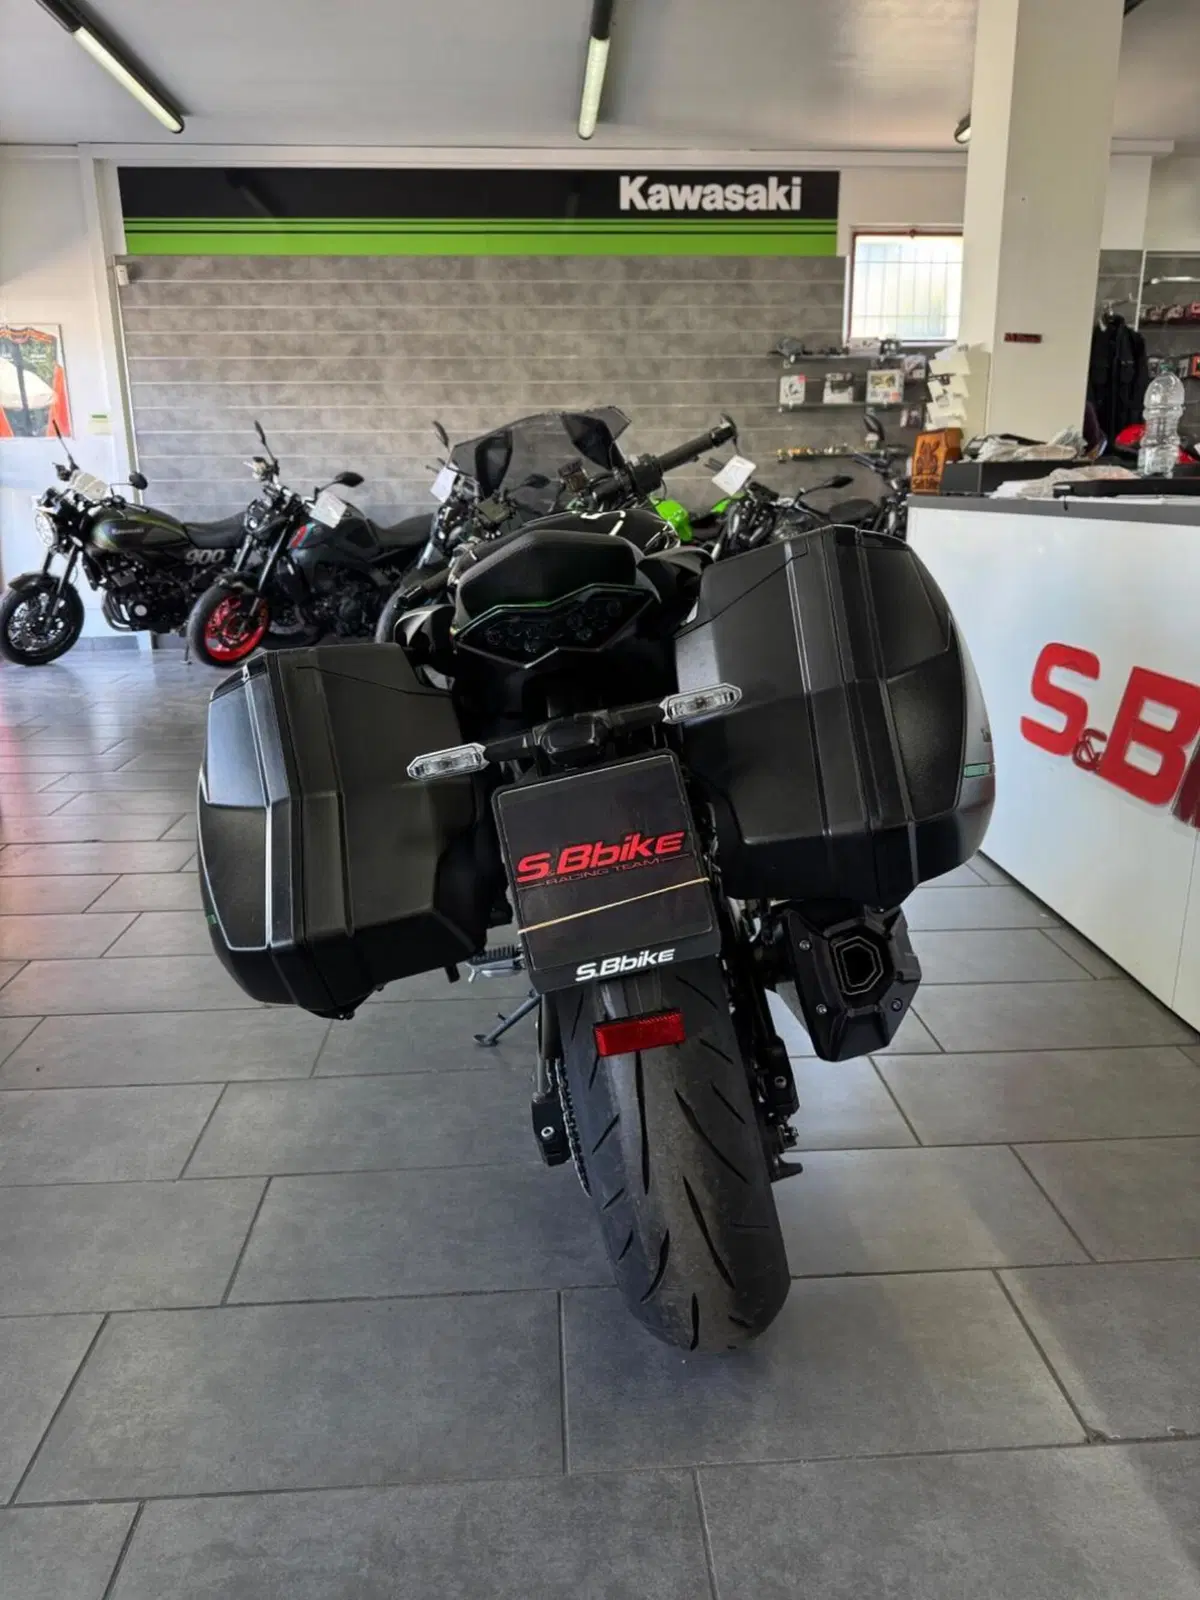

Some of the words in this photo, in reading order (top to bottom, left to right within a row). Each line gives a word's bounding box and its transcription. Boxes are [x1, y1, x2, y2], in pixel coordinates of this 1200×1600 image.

[619, 175, 802, 212] Kawasaki
[185, 548, 226, 566] 900
[545, 867, 610, 886] RACING
[615, 857, 662, 873] TEAM
